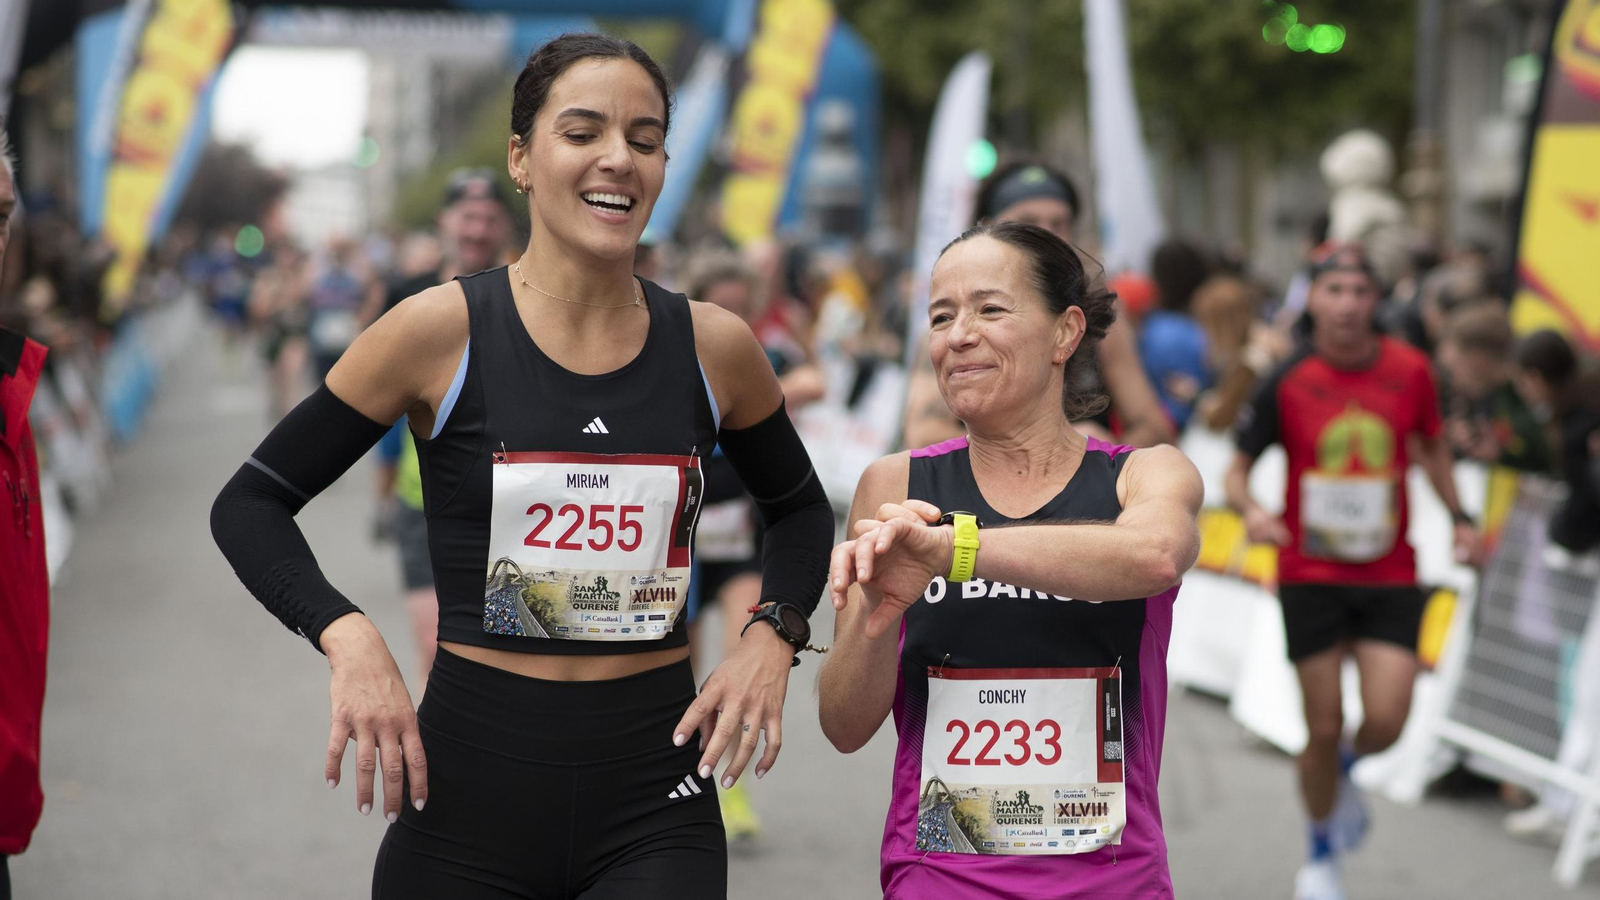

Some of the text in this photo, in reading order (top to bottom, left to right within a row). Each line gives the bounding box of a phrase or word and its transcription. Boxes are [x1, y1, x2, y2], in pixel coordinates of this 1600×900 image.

[566, 473, 609, 489] MIRIAM
[523, 502, 644, 552] 2255
[633, 587, 676, 604] XLVIII
[572, 603, 619, 611] OURENSE
[978, 689, 1027, 704] CONCHY
[946, 718, 1062, 766] 2233
[1058, 802, 1108, 817] XLVIII
